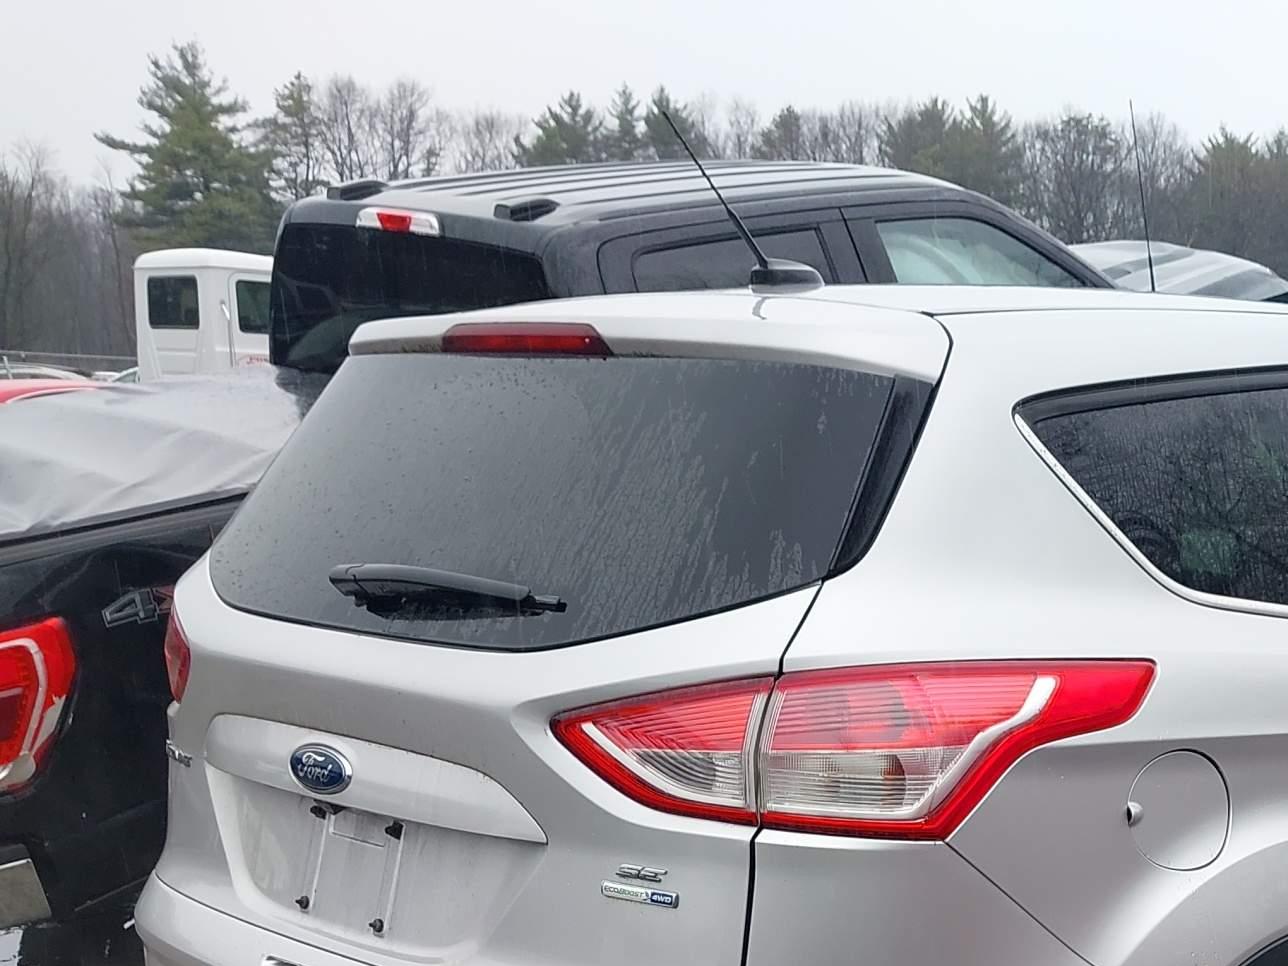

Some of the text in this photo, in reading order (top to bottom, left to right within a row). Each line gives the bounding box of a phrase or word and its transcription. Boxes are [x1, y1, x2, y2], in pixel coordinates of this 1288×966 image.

[297, 751, 334, 782] Ford
[615, 863, 668, 883] SE
[651, 894, 672, 904] 4WD
